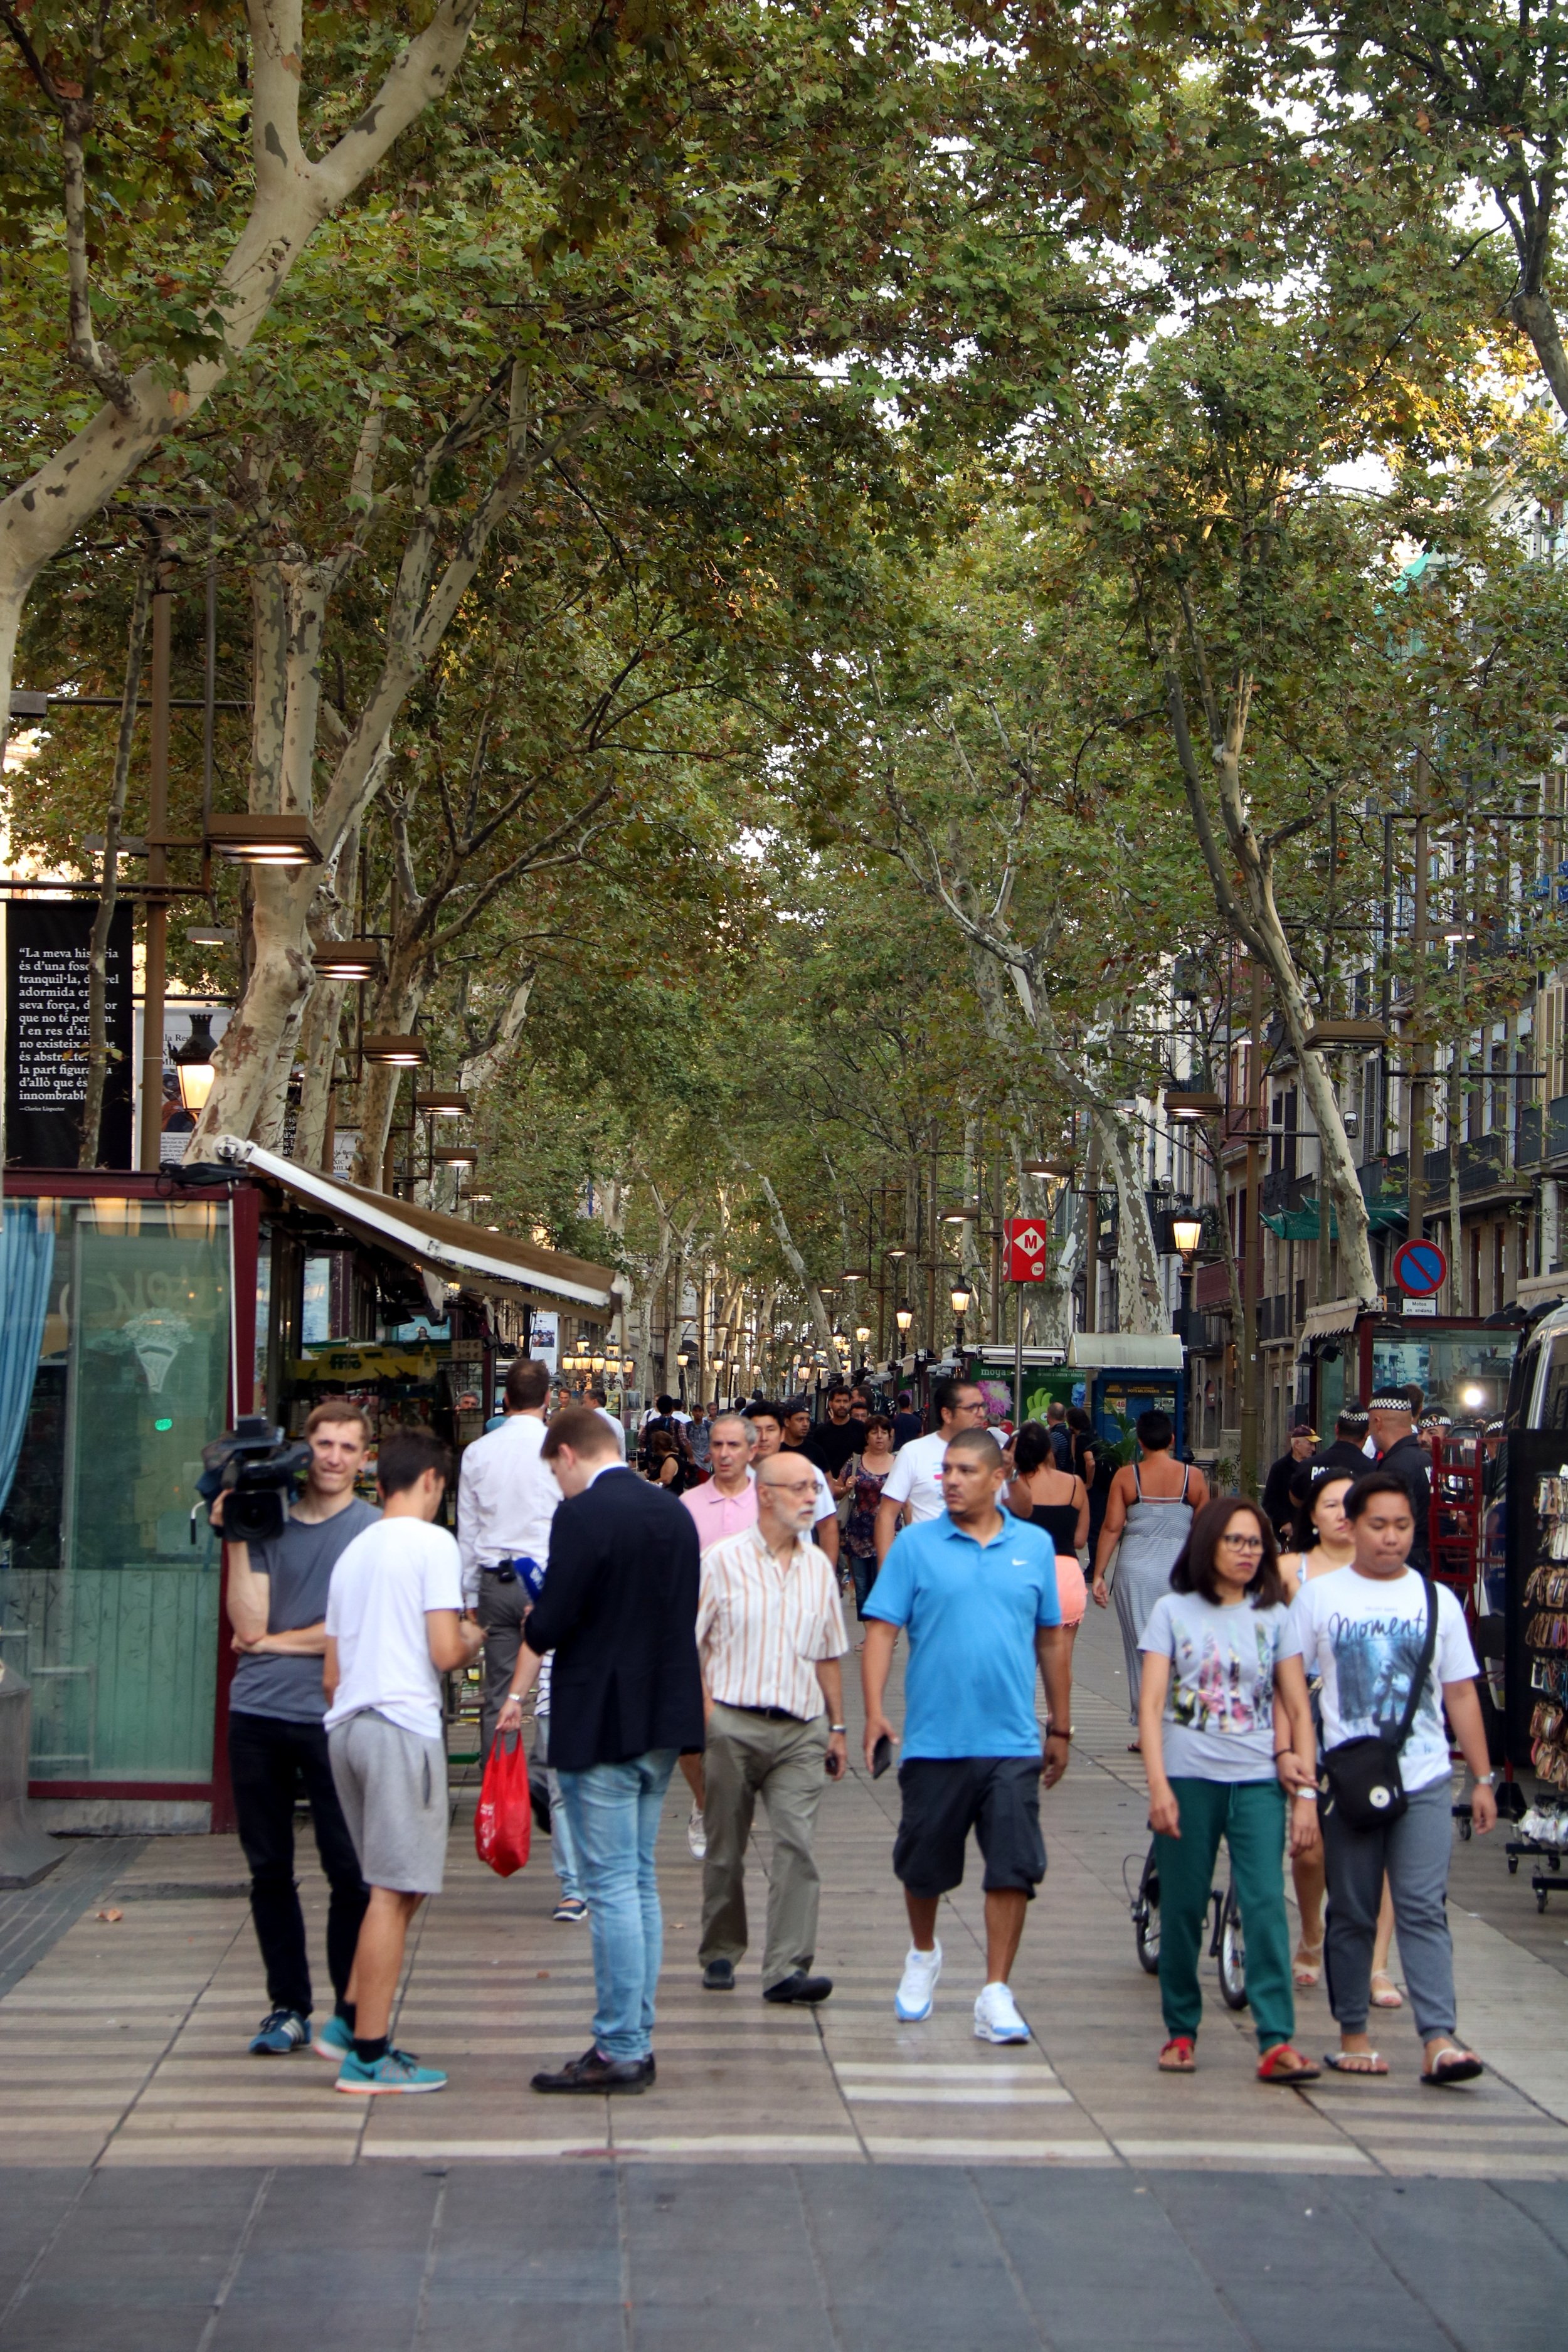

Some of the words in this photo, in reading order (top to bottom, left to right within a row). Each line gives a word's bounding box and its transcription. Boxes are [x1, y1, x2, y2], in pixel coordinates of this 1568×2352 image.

[43, 950, 72, 958] meva
[75, 948, 119, 958] hisria
[19, 960, 31, 970] és
[33, 961, 66, 970] d’una
[19, 987, 75, 997] adormida
[46, 999, 80, 1012] força,
[19, 1015, 39, 1025] que
[59, 1012, 69, 1022] té
[19, 1025, 24, 1035] I
[36, 1039, 80, 1048] existeix
[19, 1051, 31, 1061] és
[19, 1064, 29, 1074] la
[33, 1066, 56, 1076] part
[19, 1077, 50, 1087] d’allò
[53, 1080, 73, 1090] que
[77, 1077, 88, 1087] és
[1024, 1234, 1037, 1249] M
